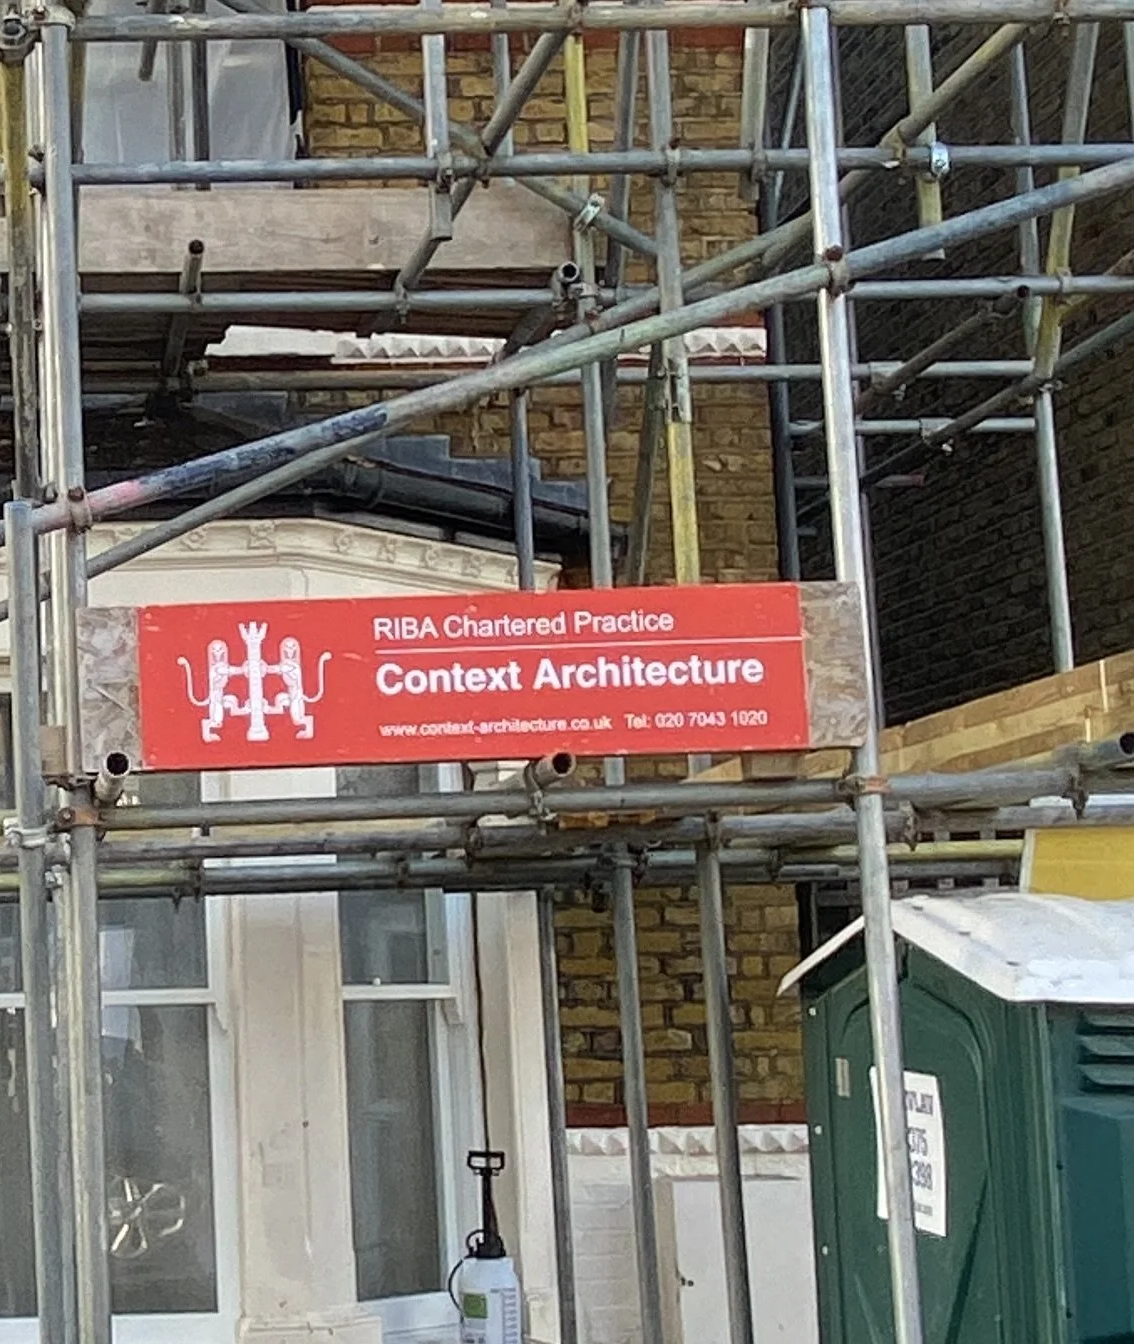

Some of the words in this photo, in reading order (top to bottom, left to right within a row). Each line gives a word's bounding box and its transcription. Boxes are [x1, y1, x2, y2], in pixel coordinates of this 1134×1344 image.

[373, 616, 439, 640] RIBA
[443, 610, 566, 638] Chartered
[574, 609, 674, 633] Practice
[376, 661, 522, 695] Context
[532, 655, 765, 690] Architecture
[379, 717, 612, 736] www.context-architecture.co.uk
[623, 712, 652, 730] Tel:
[654, 711, 684, 729] 020
[688, 710, 726, 728] 7043
[730, 709, 768, 727] 1020
